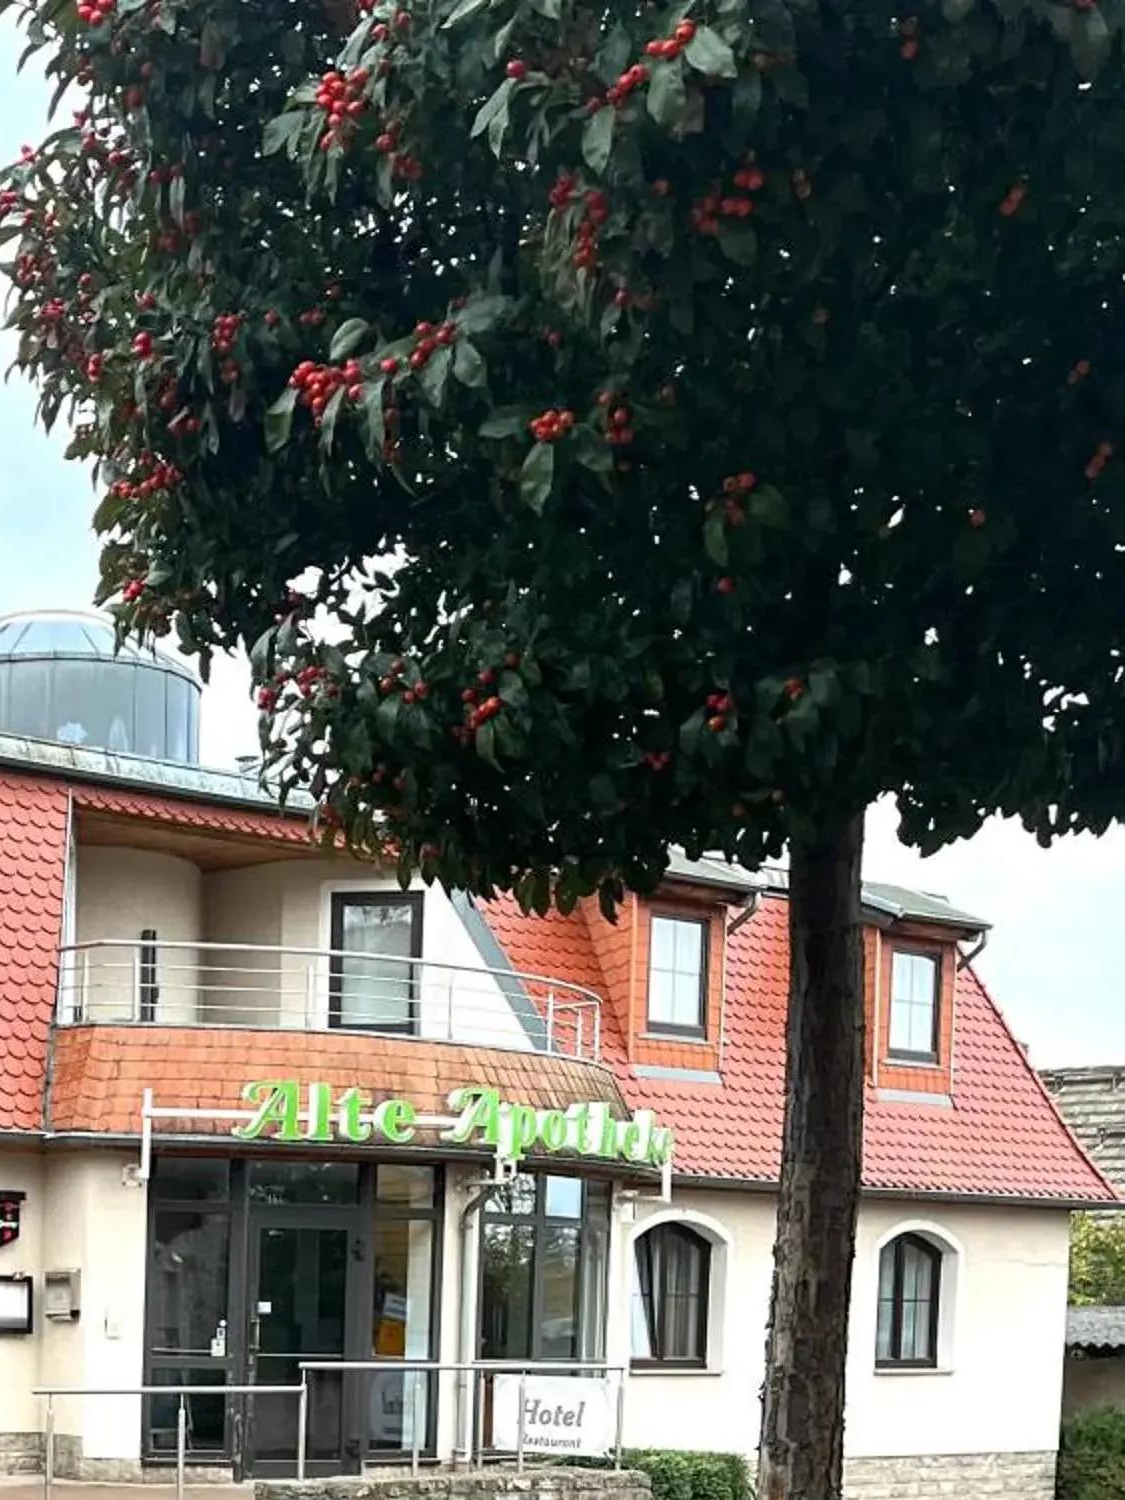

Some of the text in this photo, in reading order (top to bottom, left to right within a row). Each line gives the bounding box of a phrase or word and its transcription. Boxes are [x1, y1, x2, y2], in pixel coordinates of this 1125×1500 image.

[232, 1079, 674, 1166] Alte Apotheke
[517, 1398, 586, 1427] Hotel
